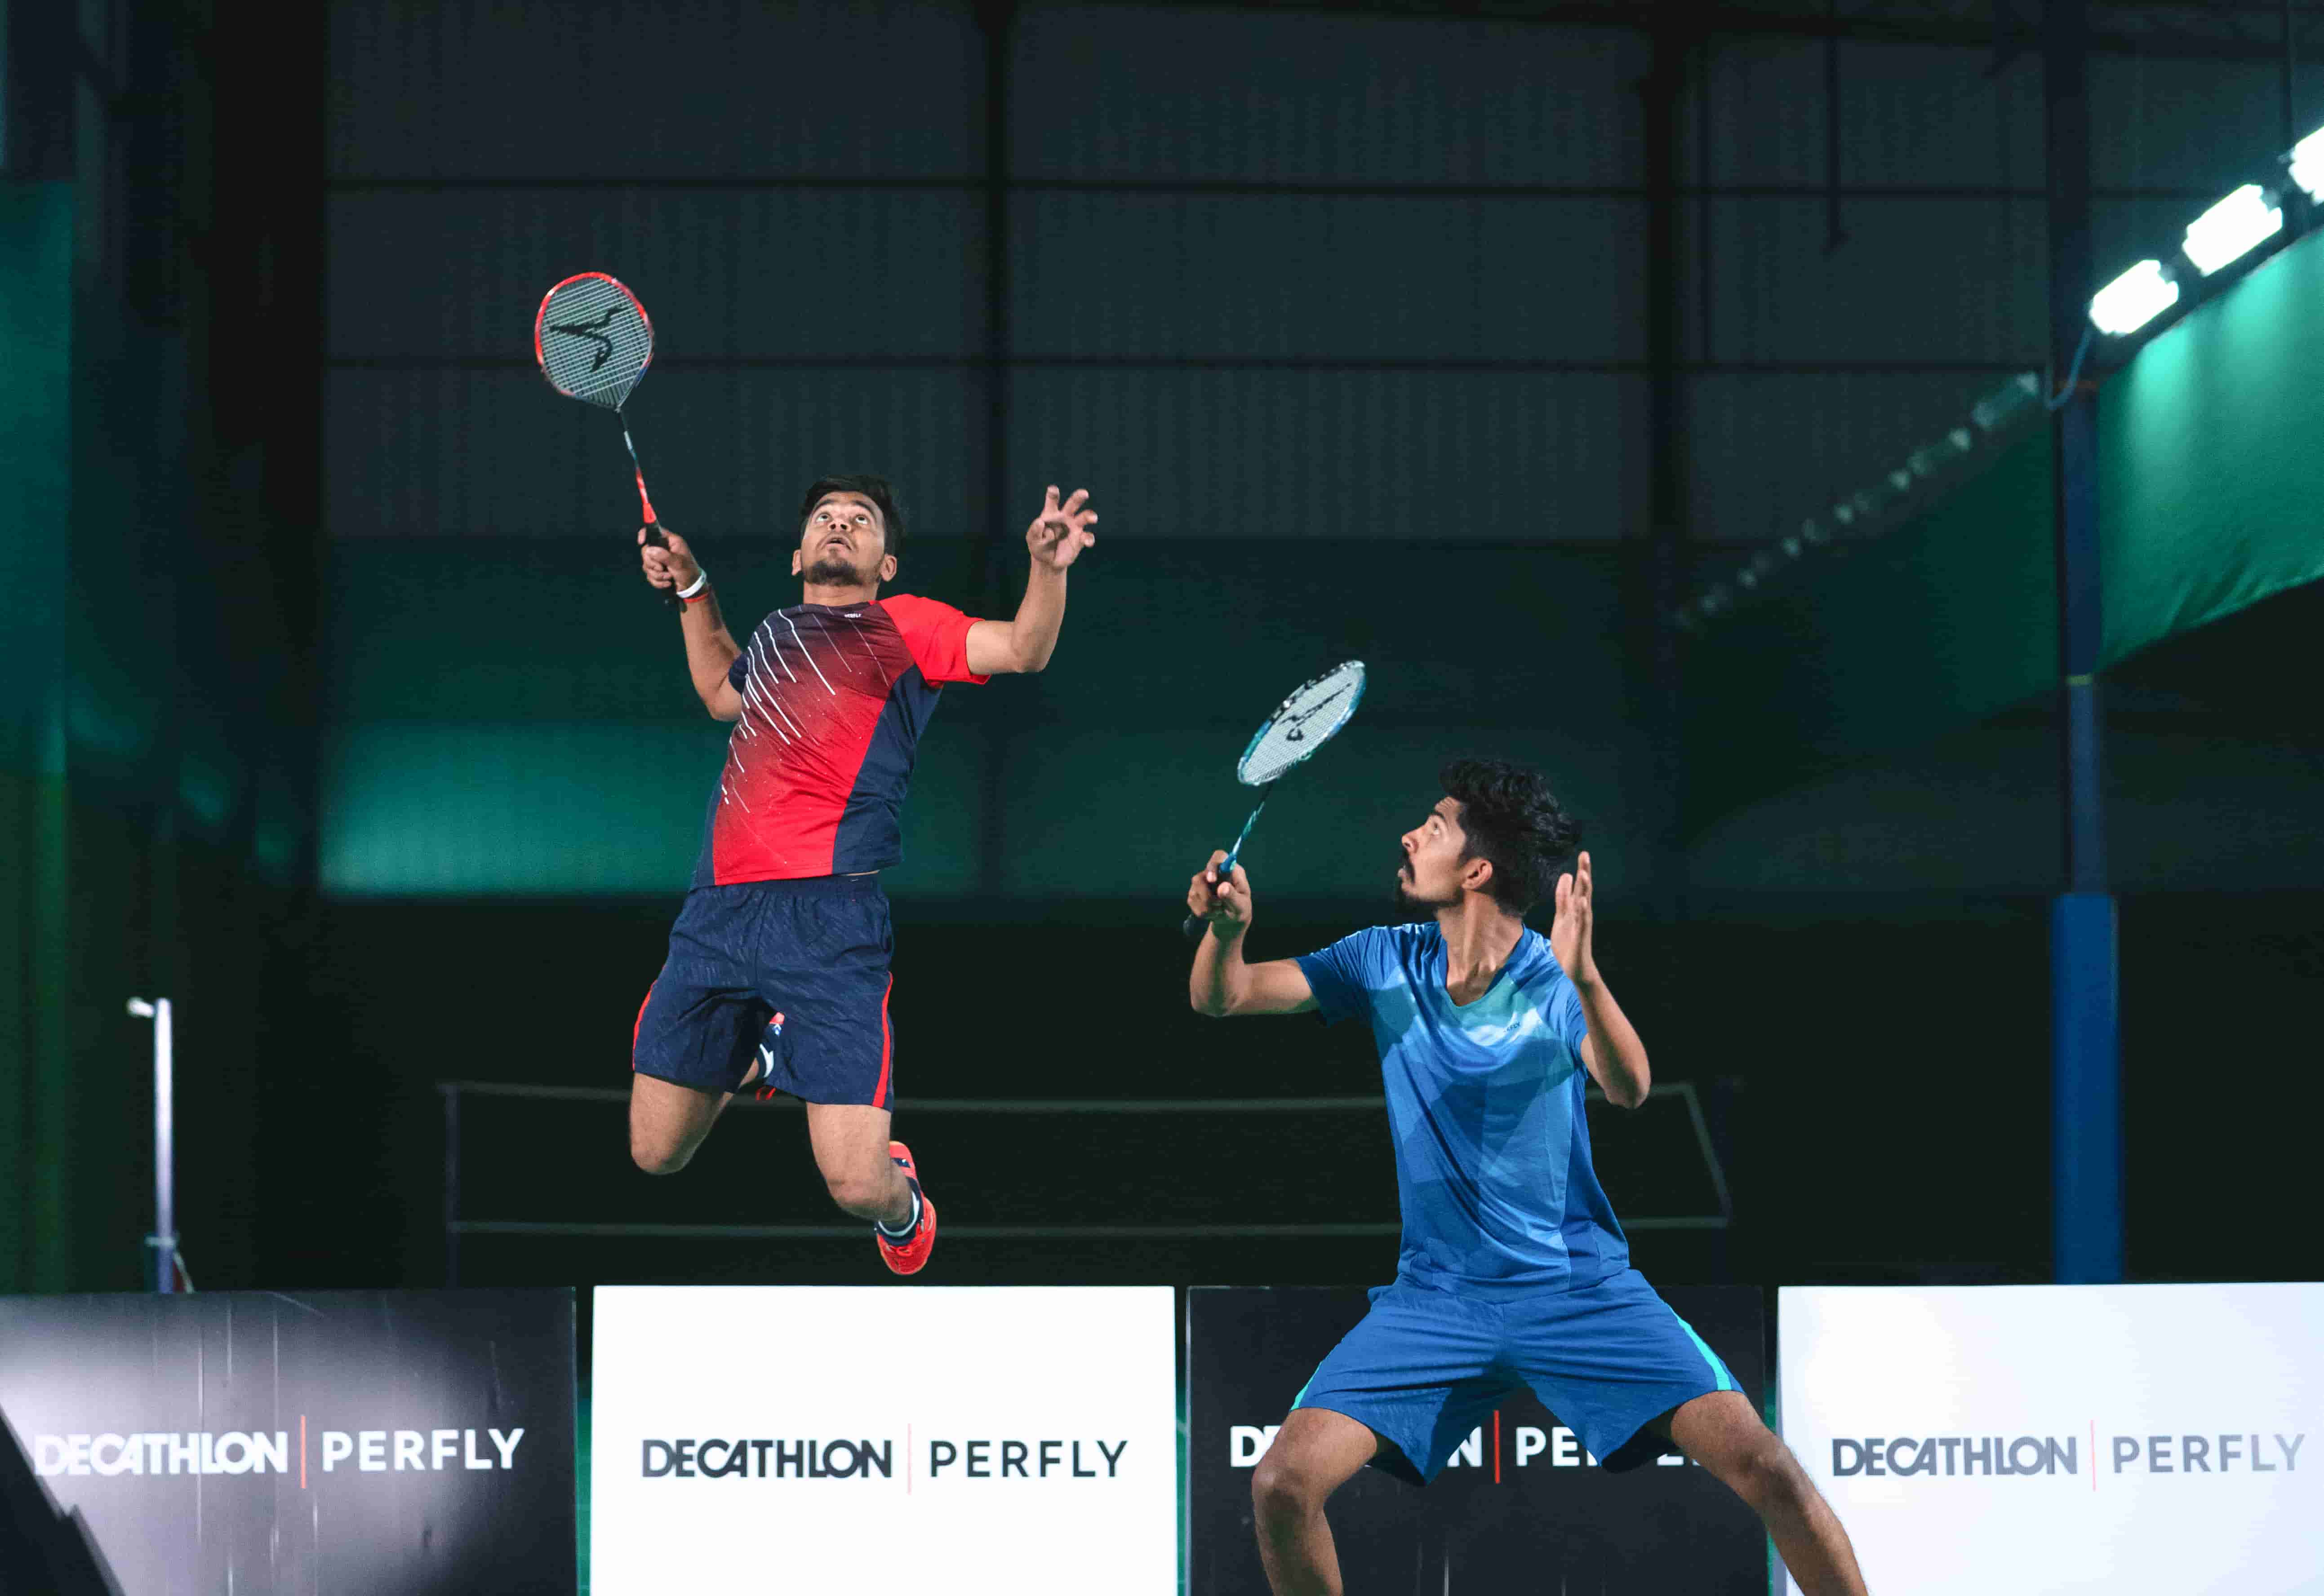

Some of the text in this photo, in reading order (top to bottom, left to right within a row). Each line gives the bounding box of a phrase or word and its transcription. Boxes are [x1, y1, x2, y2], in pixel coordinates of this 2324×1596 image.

[34, 1428, 524, 1476] DECATHLON PERFLY
[642, 1439, 1128, 1479] DECATHLON PERFLY
[1832, 1434, 2305, 1476] DECATHLON PERFLY
